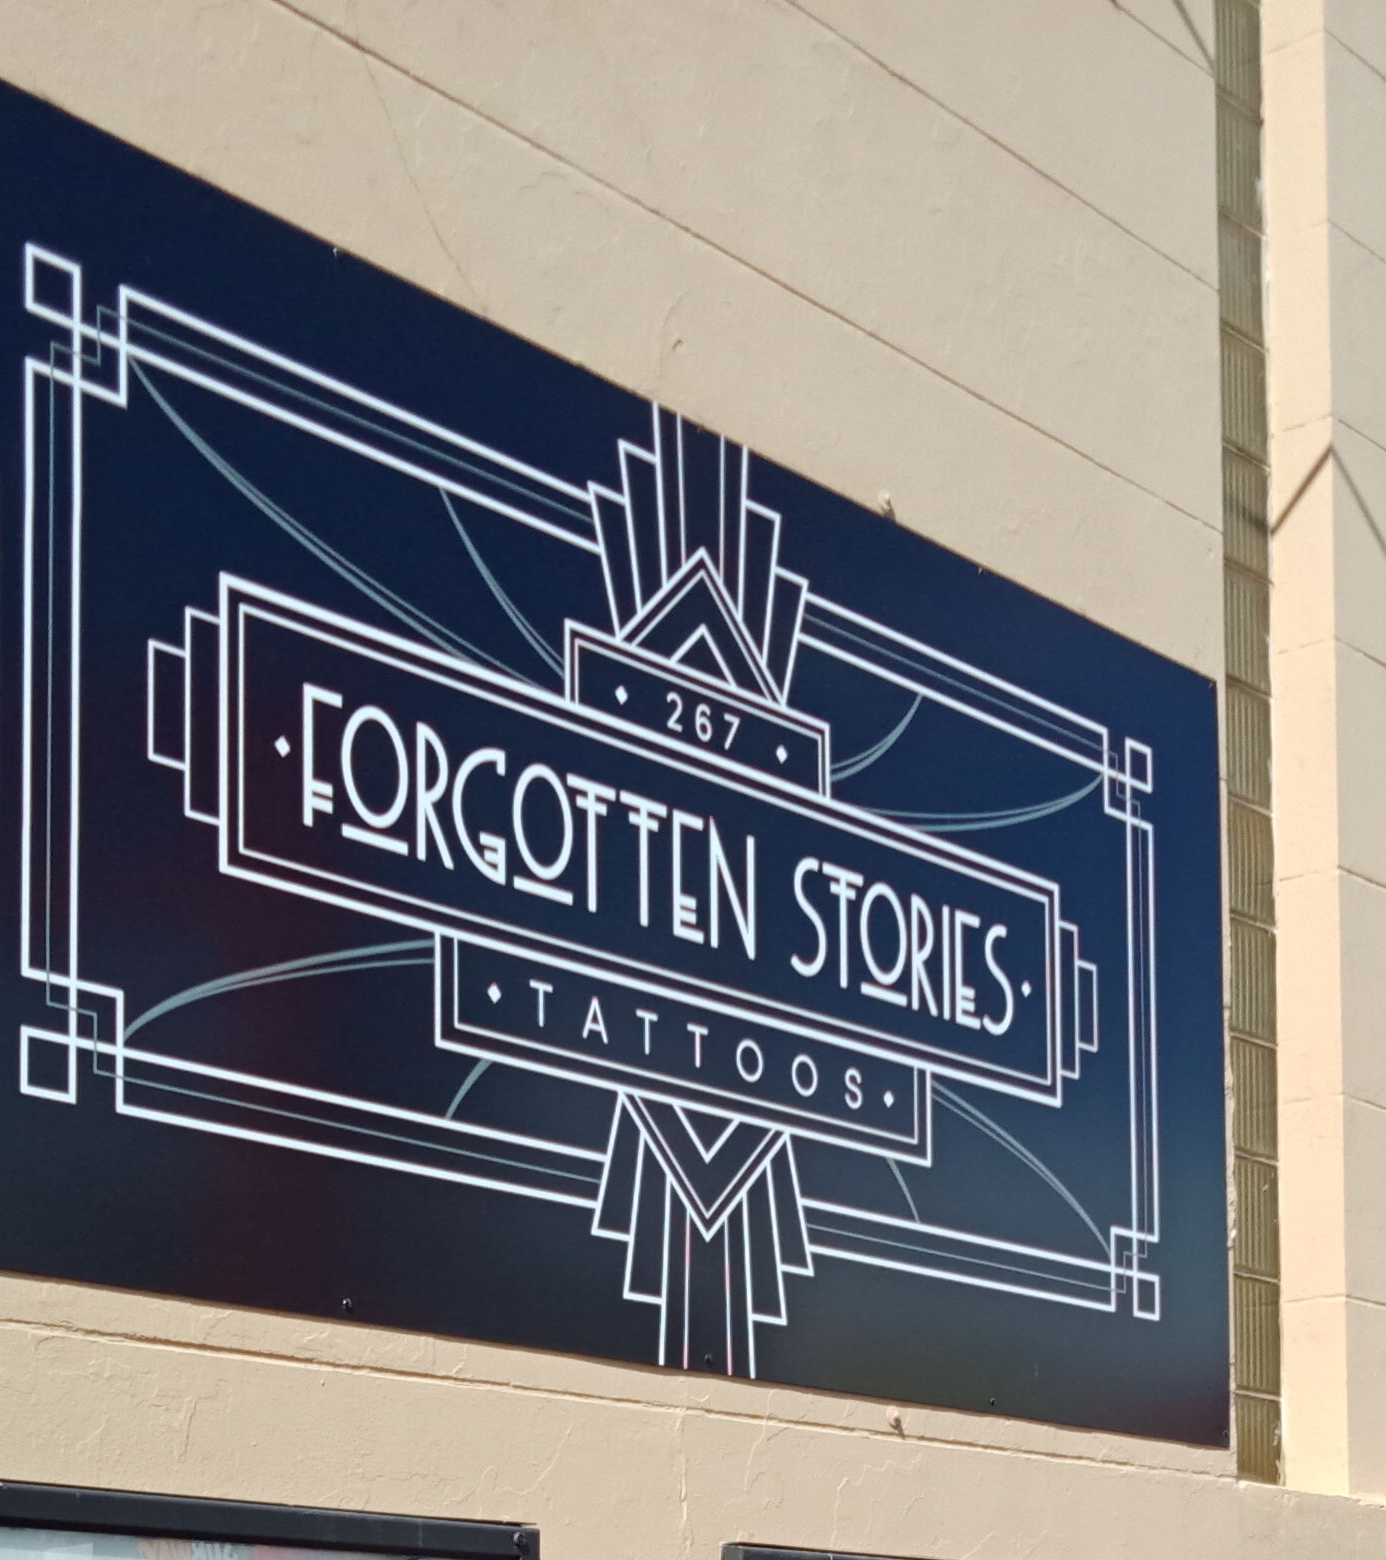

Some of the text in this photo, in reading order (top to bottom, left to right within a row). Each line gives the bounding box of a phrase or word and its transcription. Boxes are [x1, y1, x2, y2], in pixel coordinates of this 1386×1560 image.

[666, 692, 742, 751] 267
[302, 683, 1013, 1036] FORGOTTEN STORIES
[530, 979, 864, 1111] TATTOOS
